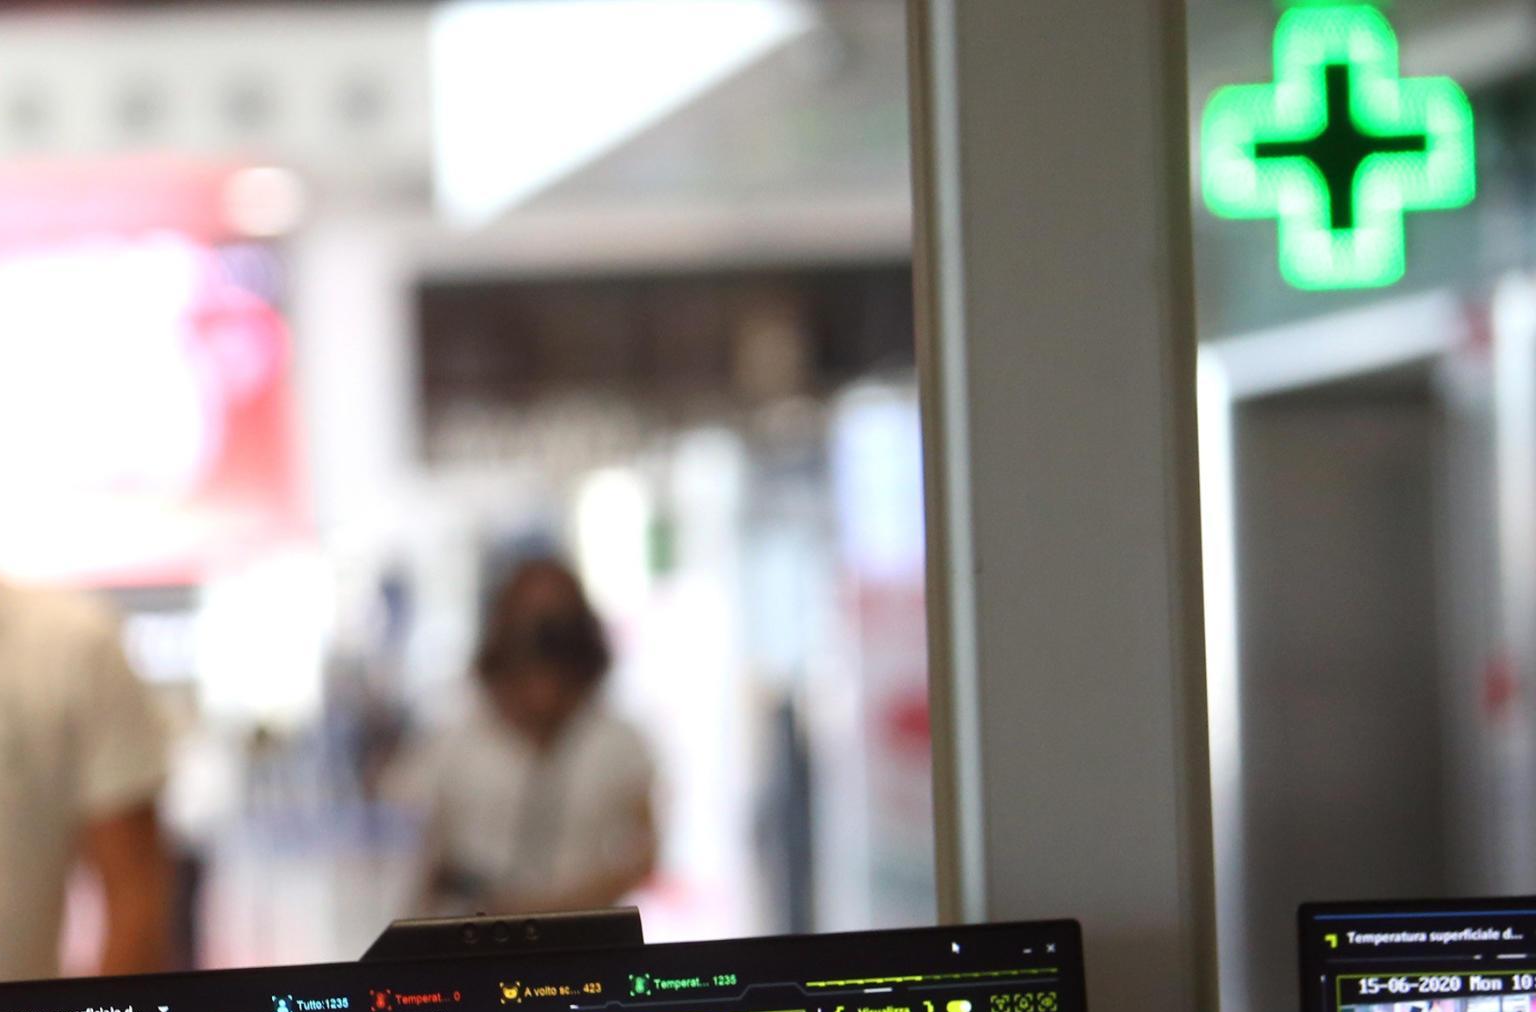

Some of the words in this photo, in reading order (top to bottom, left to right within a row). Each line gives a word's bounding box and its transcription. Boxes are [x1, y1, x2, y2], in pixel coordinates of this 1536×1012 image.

[1347, 930, 1426, 946] Temperatura
[1429, 927, 1500, 944] superficiale
[524, 986, 532, 999] A
[533, 985, 557, 998] volto
[583, 982, 602, 994] 423
[1358, 976, 1462, 995] 15-06-2020
[1469, 975, 1502, 992] Mon
[453, 990, 462, 1002] 0
